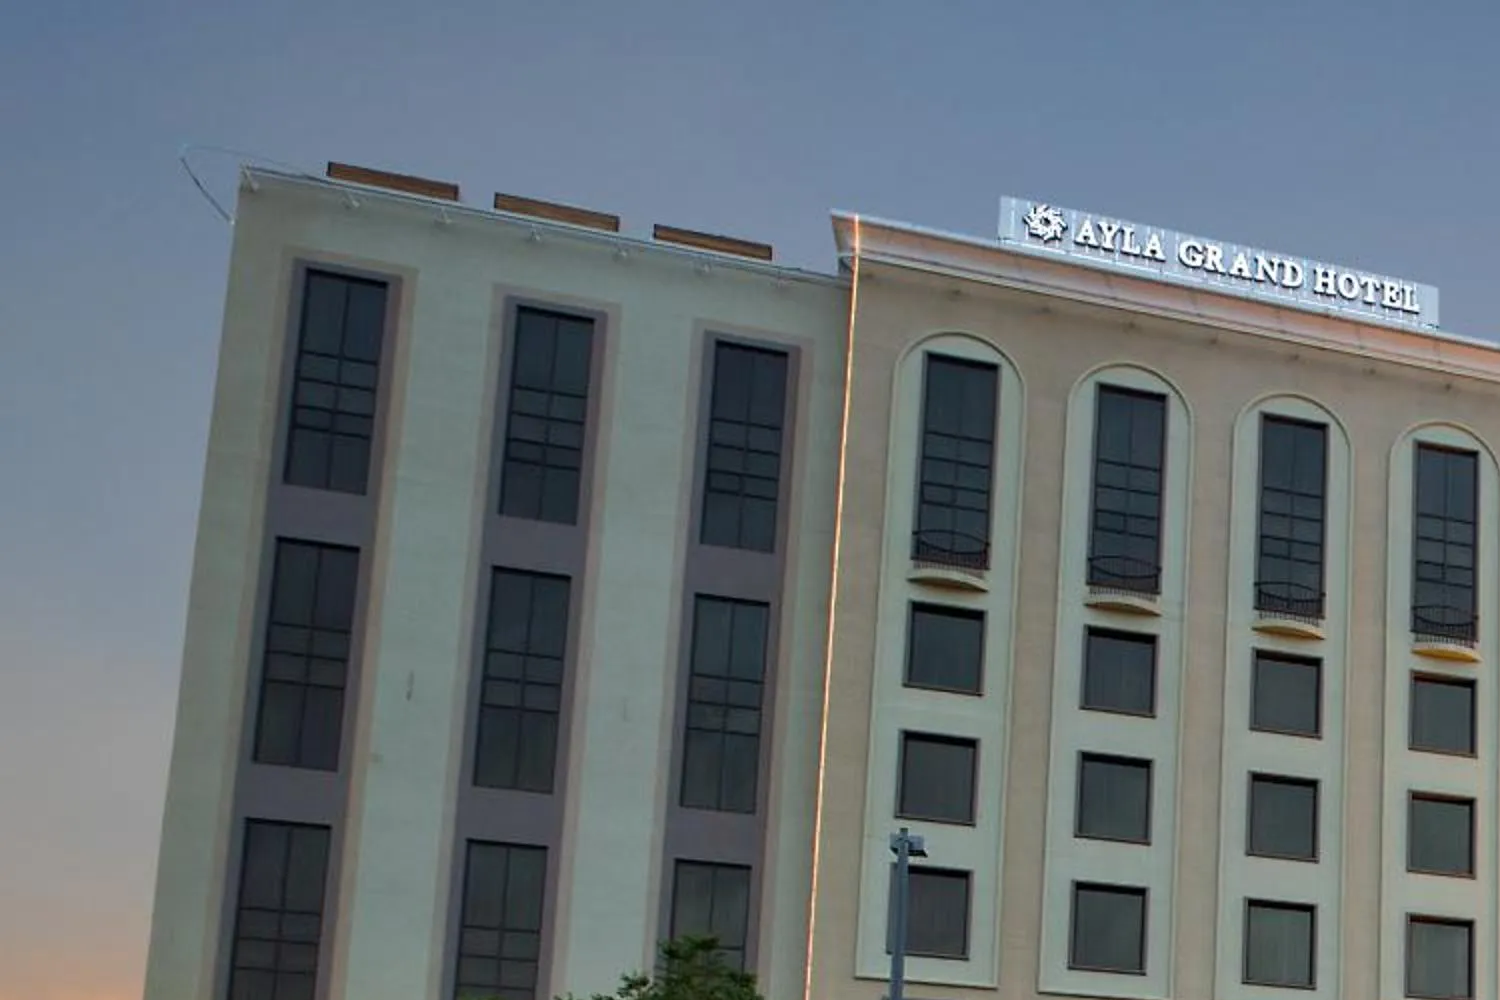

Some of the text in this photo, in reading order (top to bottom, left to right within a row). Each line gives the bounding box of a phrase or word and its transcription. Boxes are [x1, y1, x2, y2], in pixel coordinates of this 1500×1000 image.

[1074, 219, 1420, 314] AYLA GRAND HOTEL
